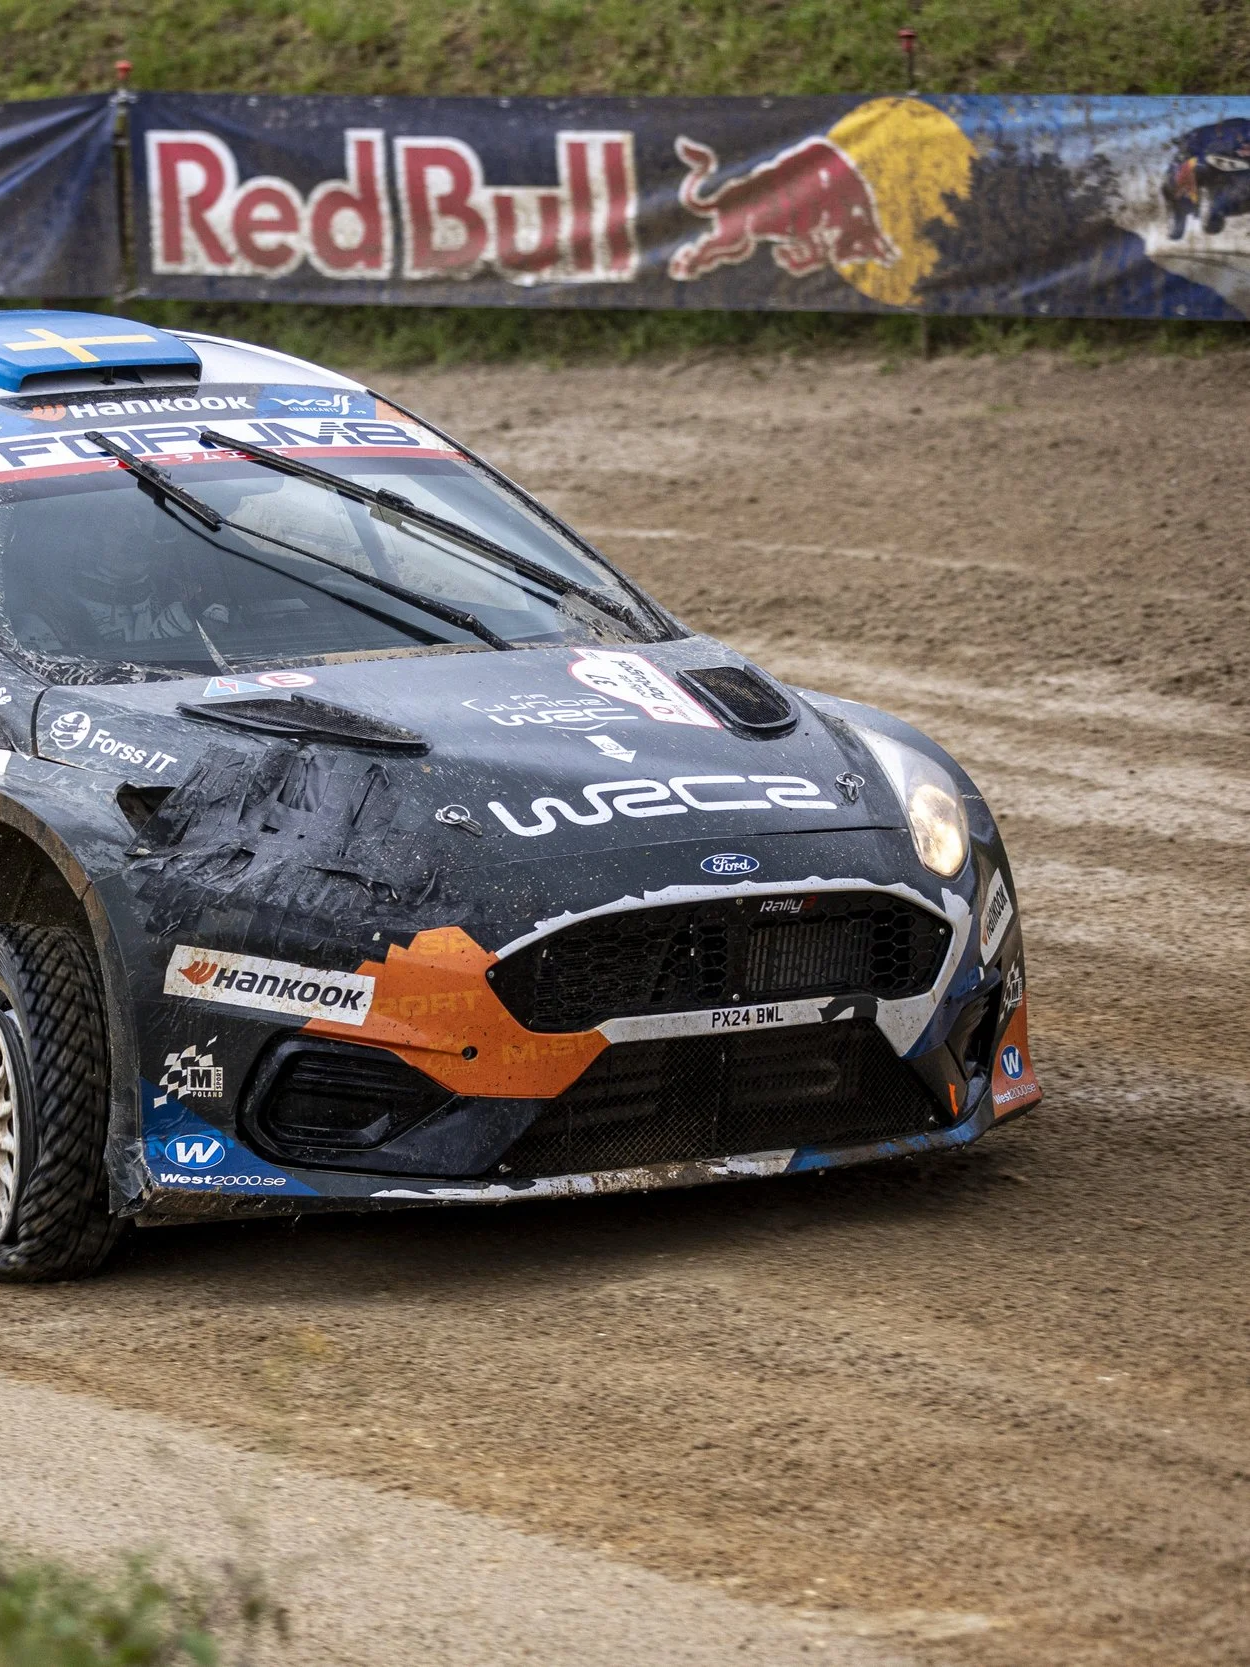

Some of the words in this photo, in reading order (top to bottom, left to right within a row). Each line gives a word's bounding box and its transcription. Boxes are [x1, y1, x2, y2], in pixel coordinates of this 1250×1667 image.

[483, 699, 607, 712] JUNIOR
[488, 708, 639, 726] WRC
[88, 728, 144, 764] Forss
[145, 751, 178, 774] IT
[487, 775, 838, 837] WRC2
[713, 856, 751, 872] Ford
[712, 1009, 750, 1028] PX24
[756, 1006, 784, 1024] BWL
[1002, 1048, 1019, 1075] W
[215, 1068, 223, 1090] SPORT
[176, 1139, 221, 1163] W
[160, 1172, 287, 1186] West2000.se
